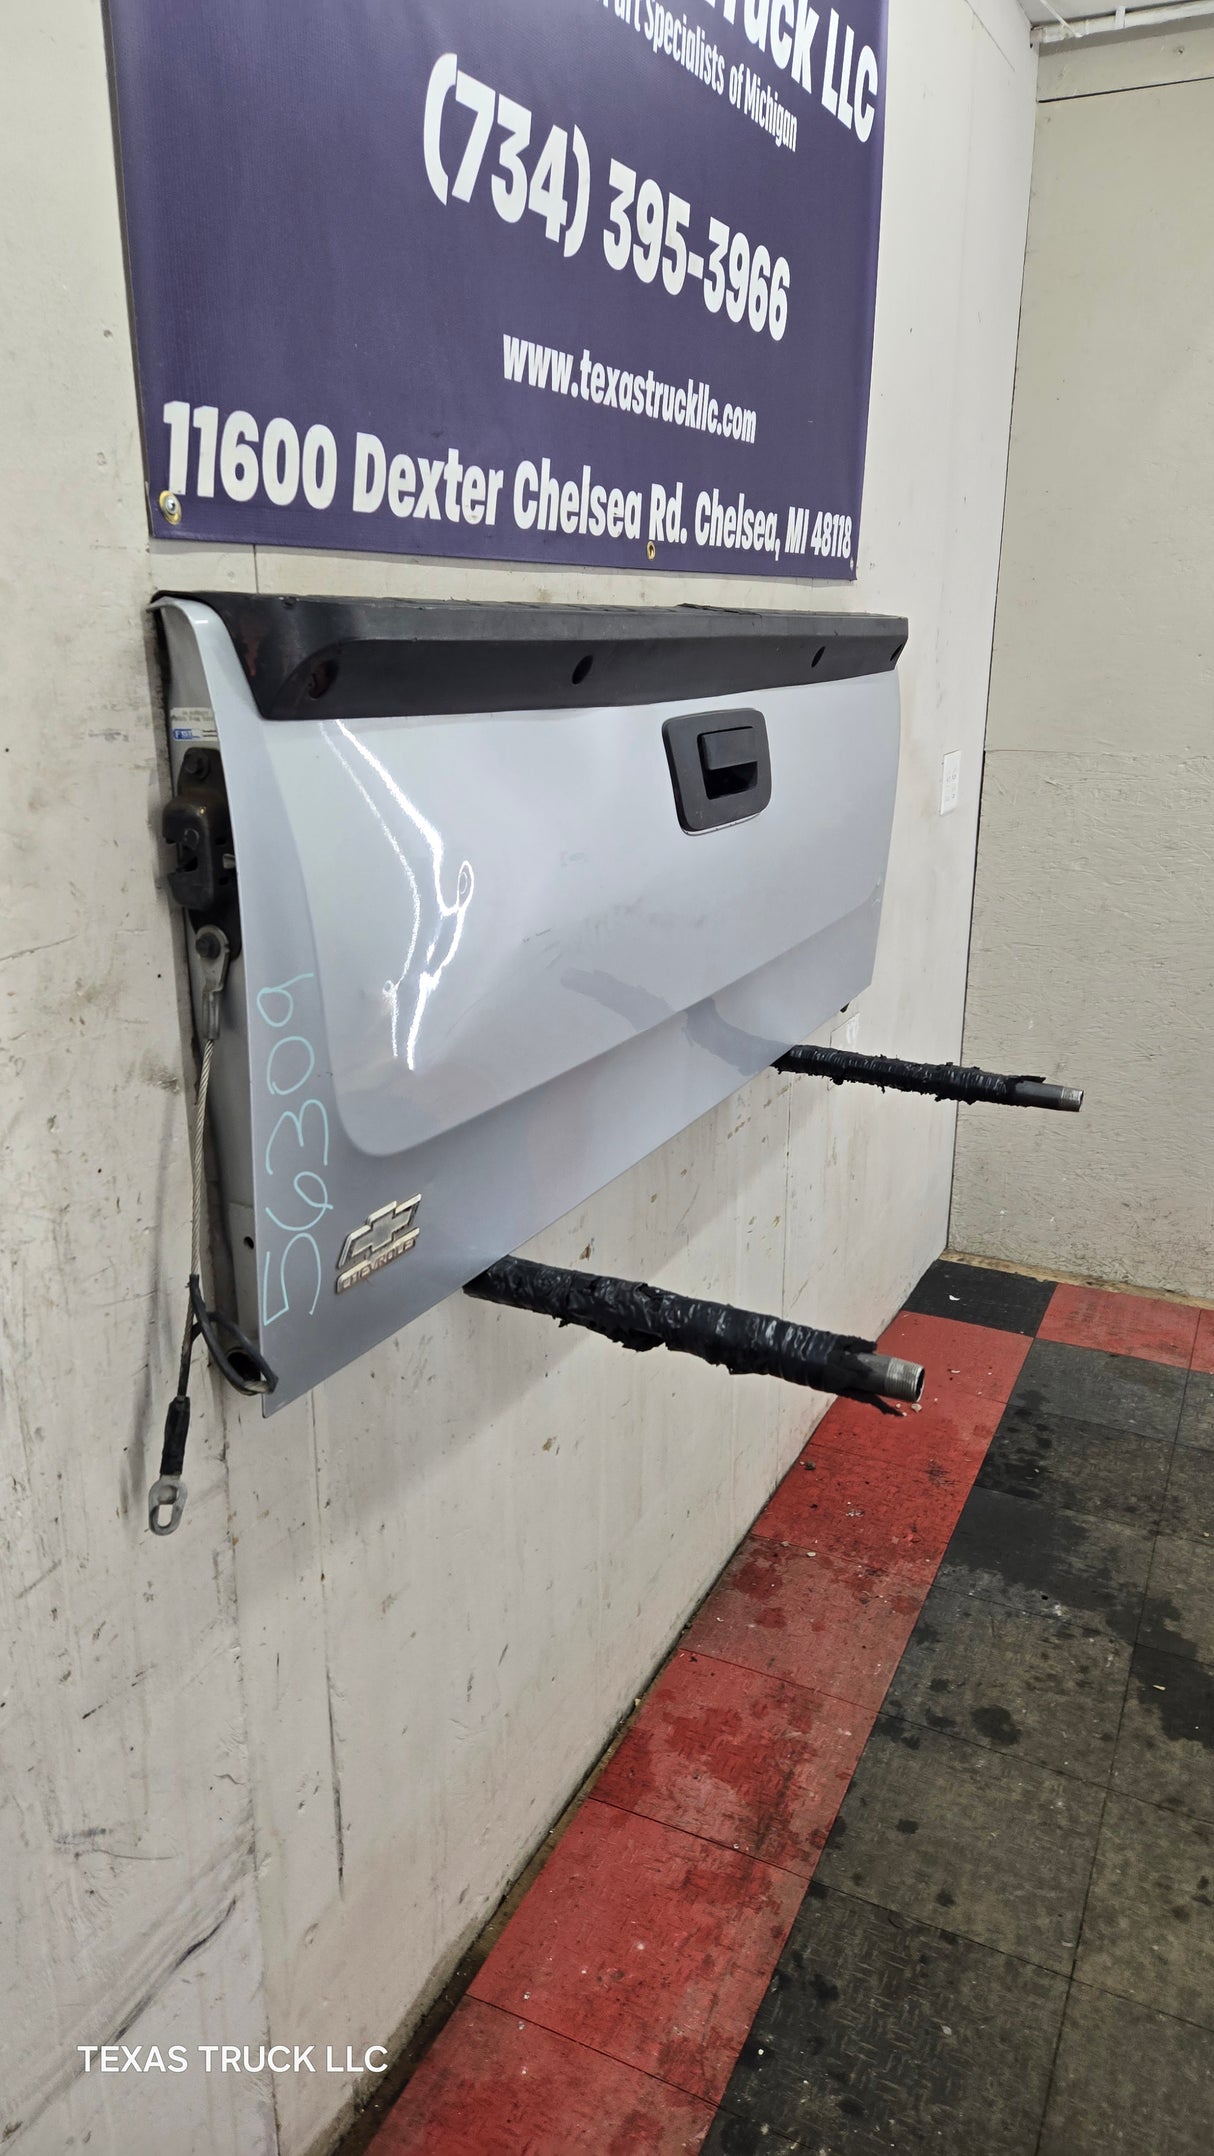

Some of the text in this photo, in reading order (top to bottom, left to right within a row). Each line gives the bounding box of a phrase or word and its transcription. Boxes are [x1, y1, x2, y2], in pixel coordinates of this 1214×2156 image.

[643, 0, 798, 153] Specialists of Michigan
[822, 7, 879, 143] LLC
[424, 52, 791, 342] (734) 395-3966
[503, 333, 757, 444] www.texastruckllc.com
[162, 400, 852, 562] 11600 Dexter Chelsea Rd. Chelsea, MI 48118
[257, 972, 334, 1326] 56309
